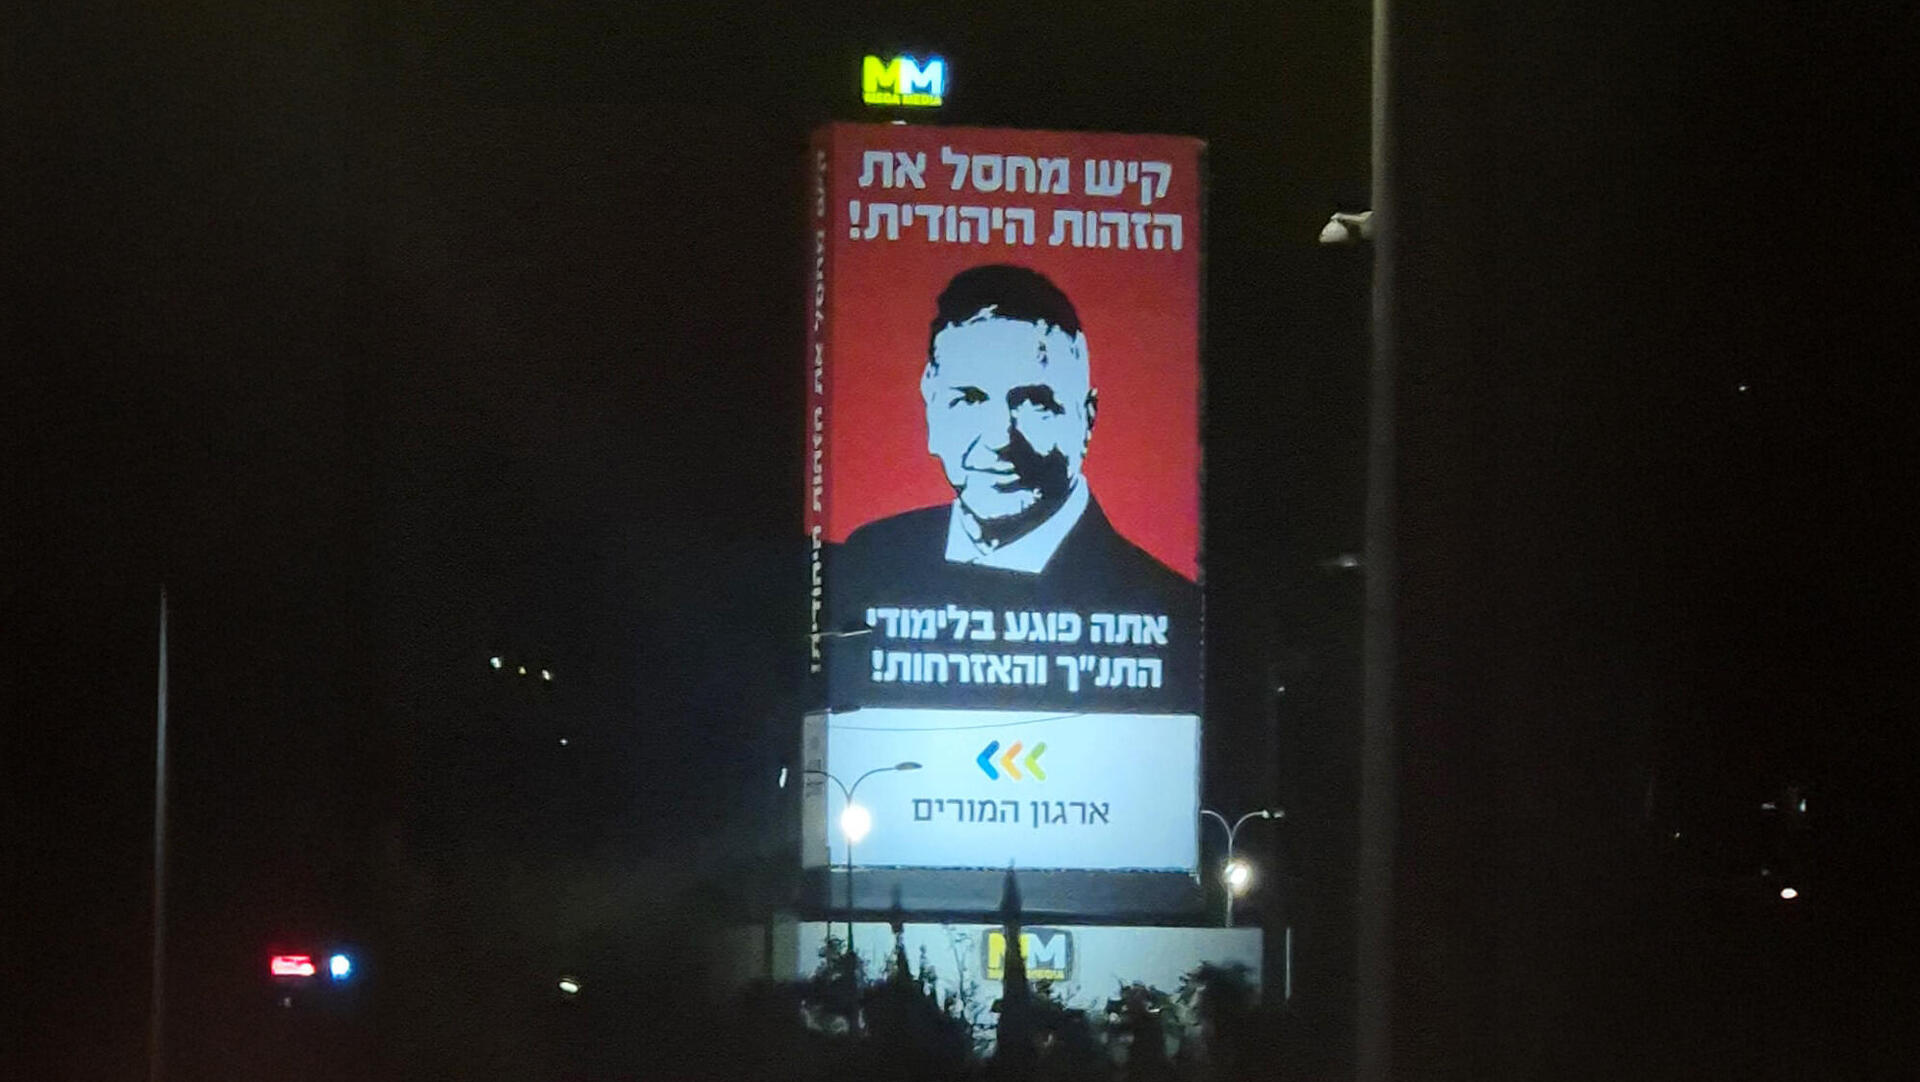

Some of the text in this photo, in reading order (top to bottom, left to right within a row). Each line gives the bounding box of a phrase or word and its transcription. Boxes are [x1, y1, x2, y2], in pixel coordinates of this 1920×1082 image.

[863, 55, 945, 94] MM
[858, 146, 1172, 206] קיש מחסל את
[849, 200, 1183, 251] הזהות היהודית!
[866, 604, 1168, 645] אתה פוגע בלימודי
[872, 649, 1048, 685] והאזרחות!
[911, 798, 1109, 828] ארגון המורים
